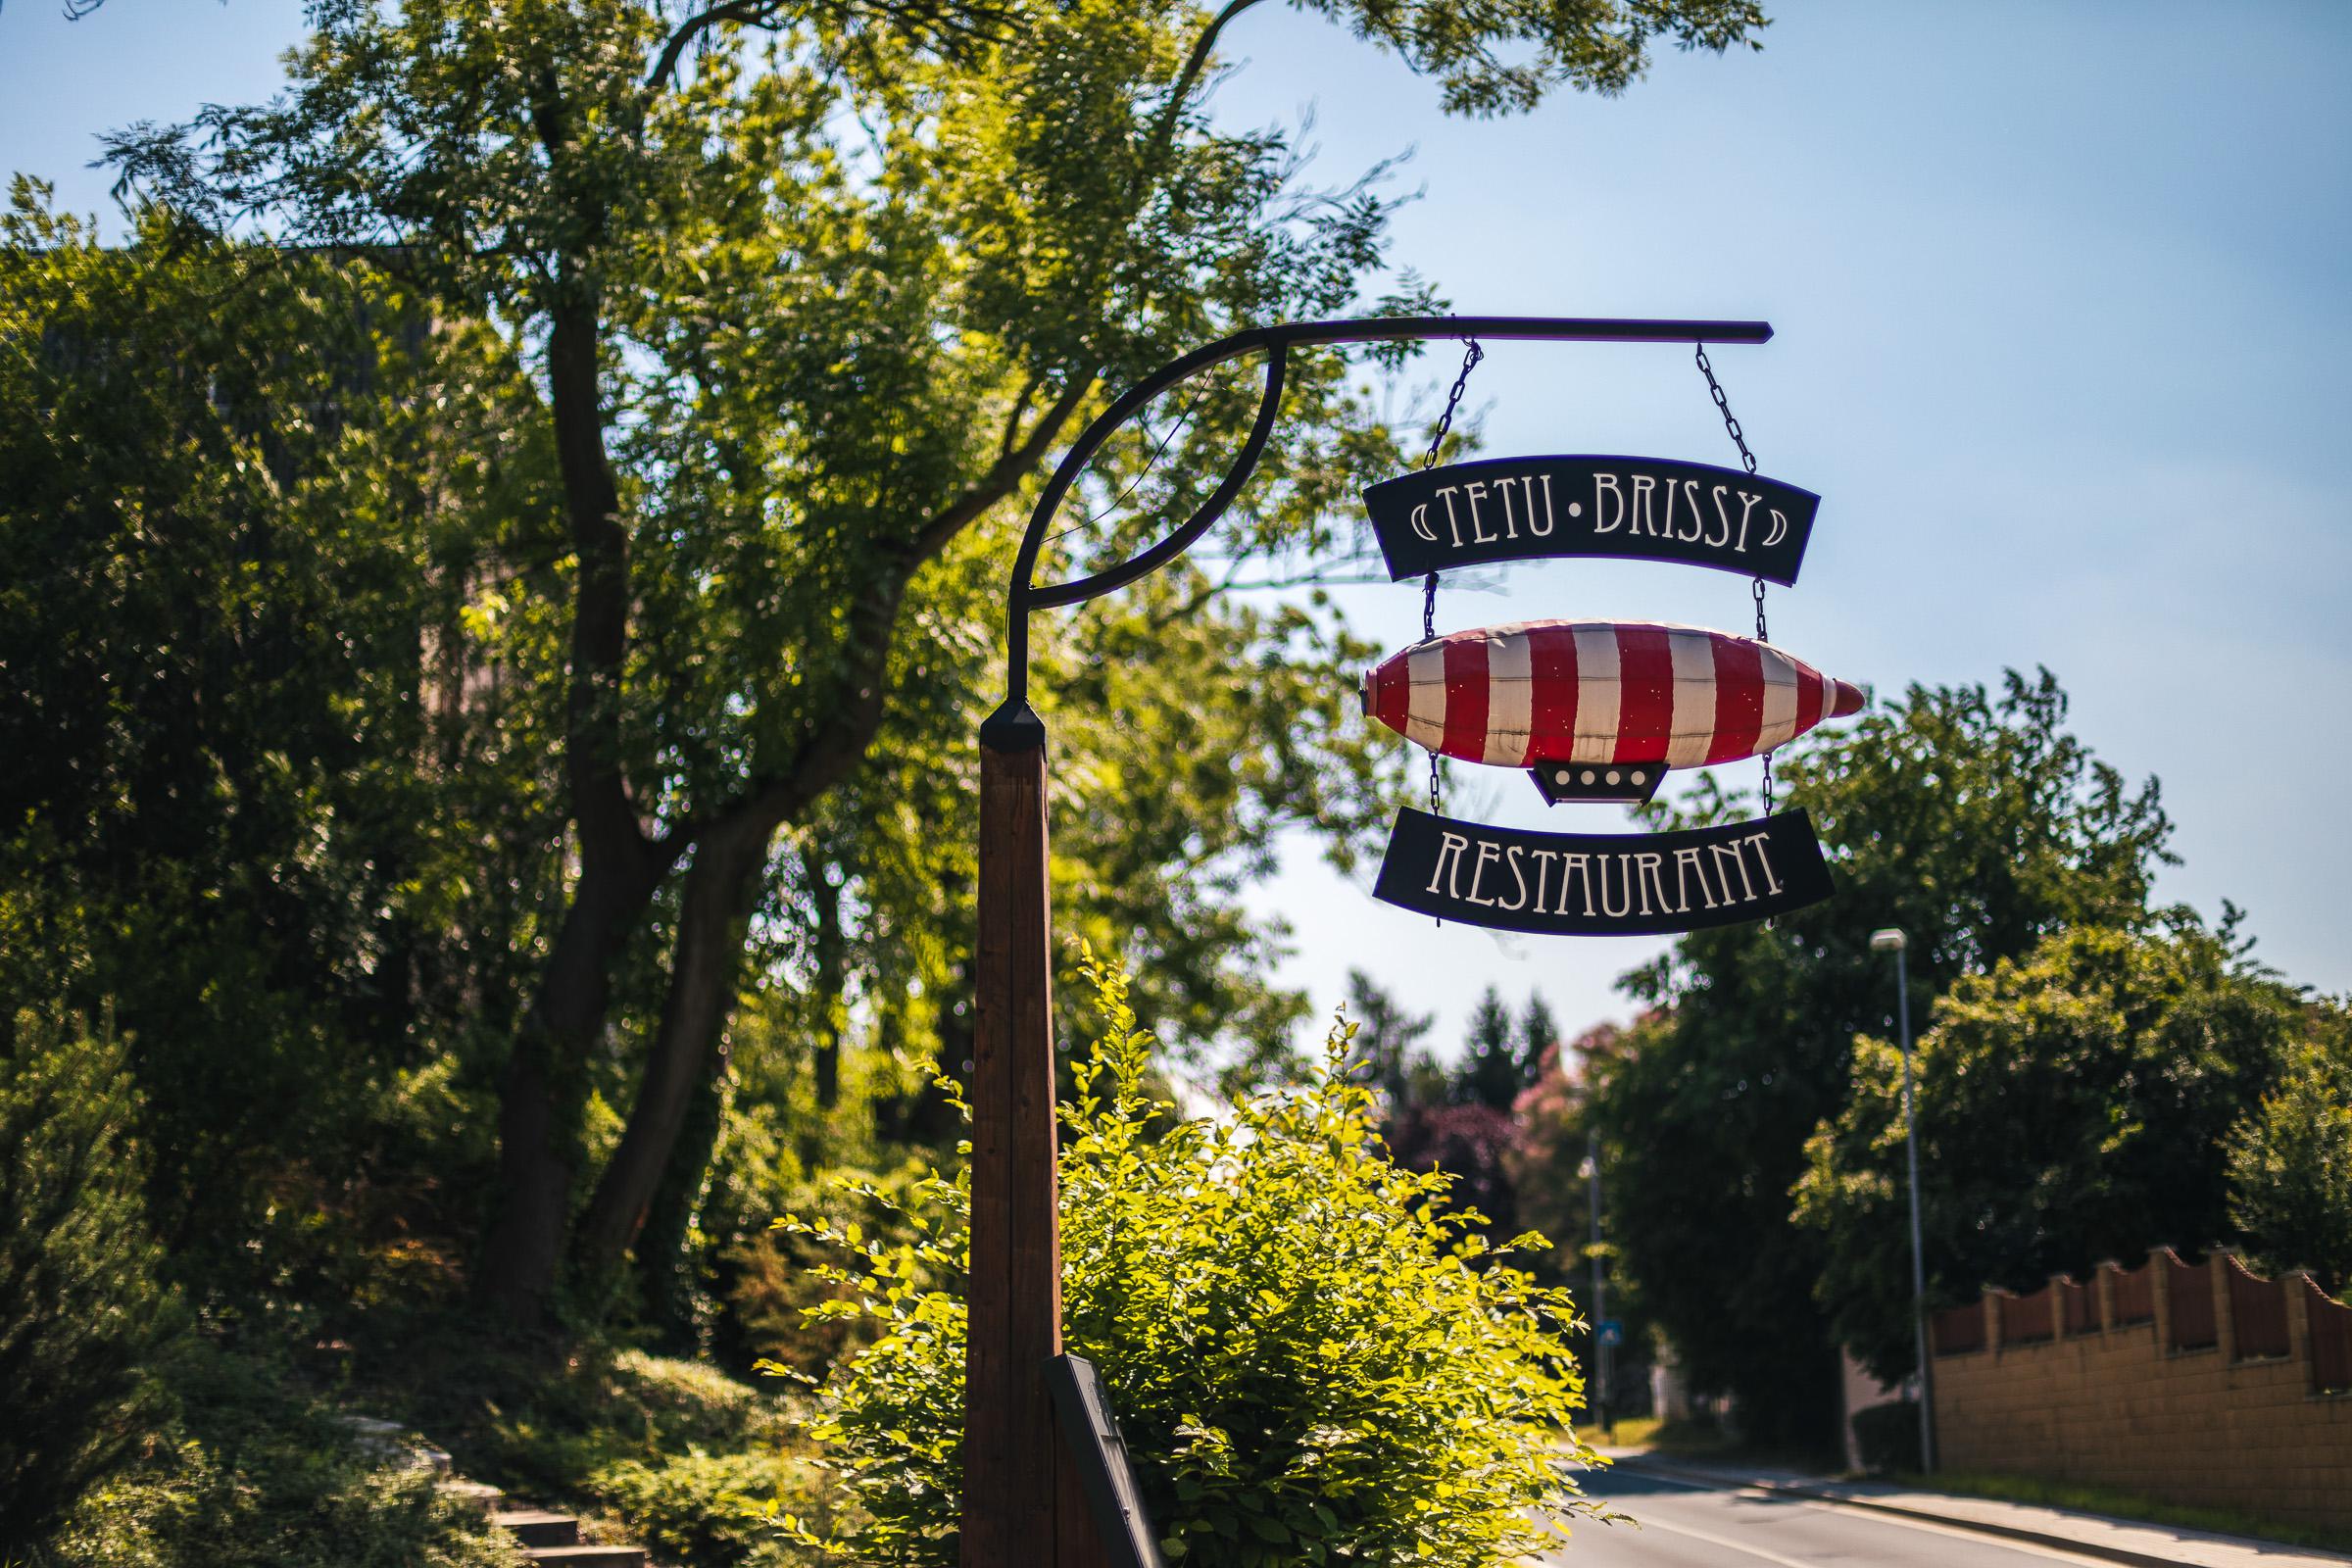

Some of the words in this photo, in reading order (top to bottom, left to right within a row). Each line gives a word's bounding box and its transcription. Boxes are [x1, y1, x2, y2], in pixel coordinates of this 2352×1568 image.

[1436, 474, 1553, 548] TETU
[1592, 472, 1763, 553] BRISSY
[1426, 831, 1783, 918] RESTAURANT
